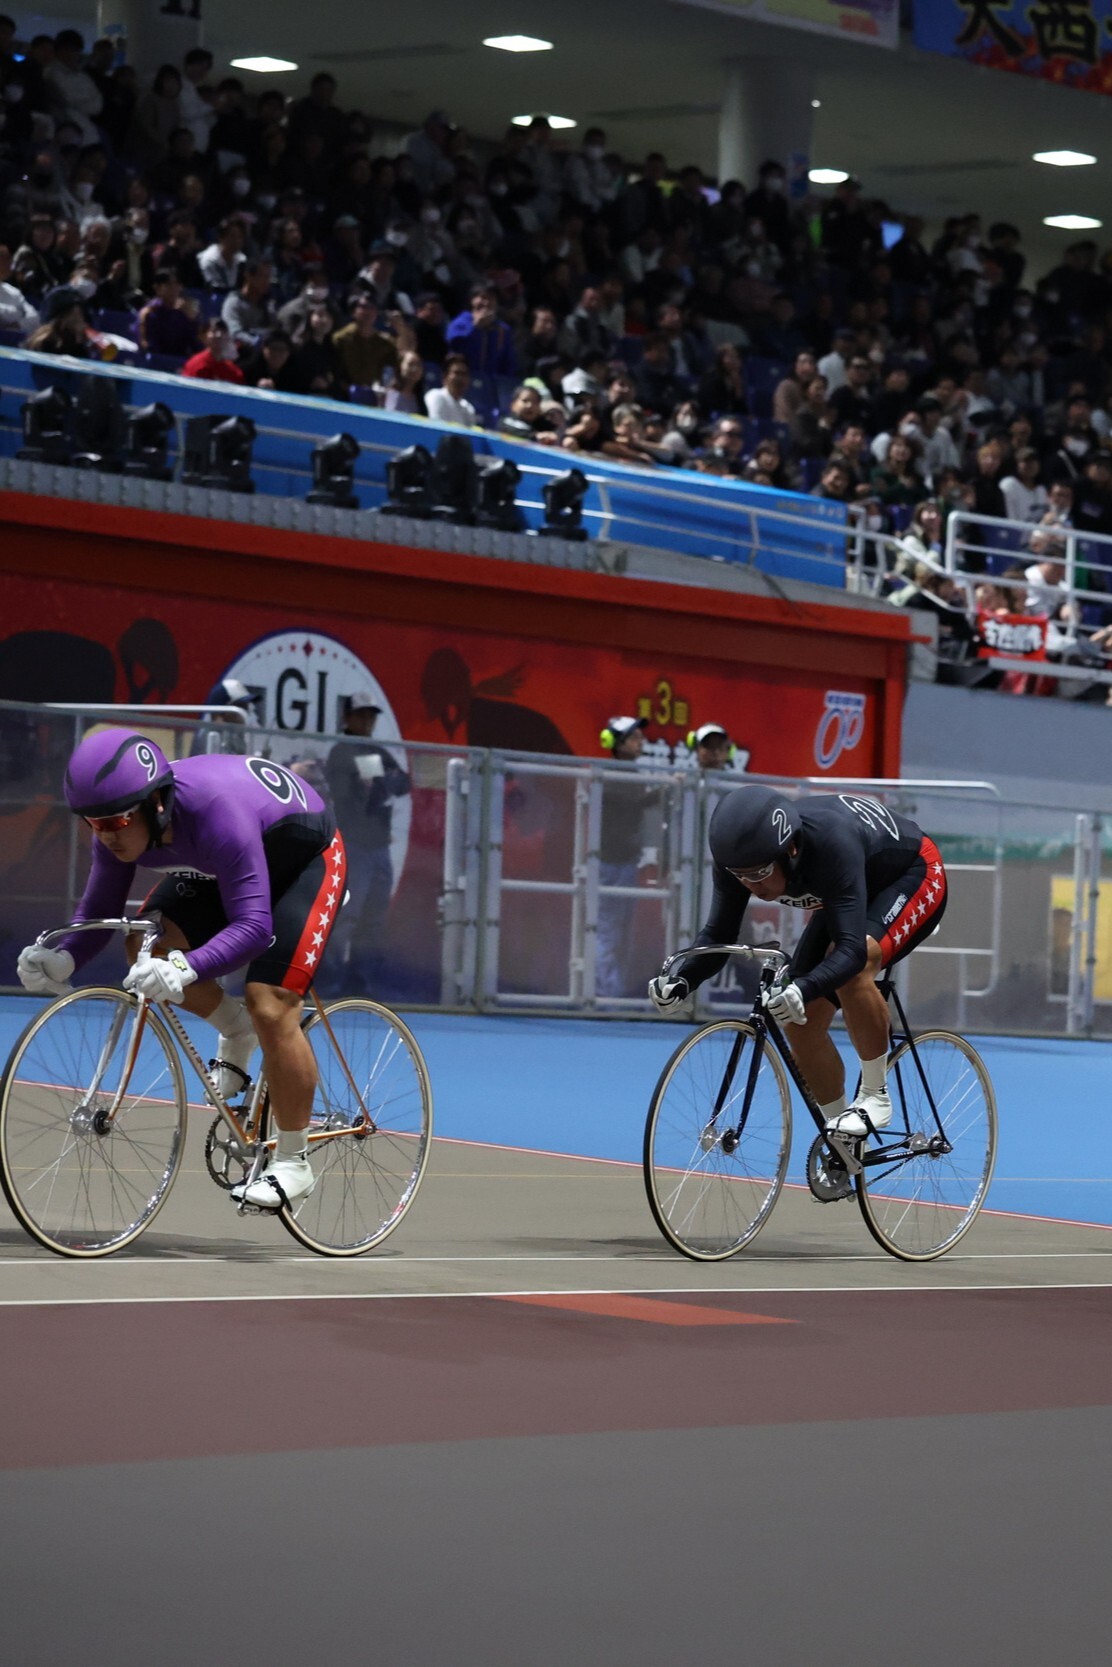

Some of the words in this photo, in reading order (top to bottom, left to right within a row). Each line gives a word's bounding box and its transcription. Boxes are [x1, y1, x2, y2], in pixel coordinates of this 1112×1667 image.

[136, 743, 158, 782] 9
[245, 757, 308, 811] 9
[772, 808, 792, 845] 2
